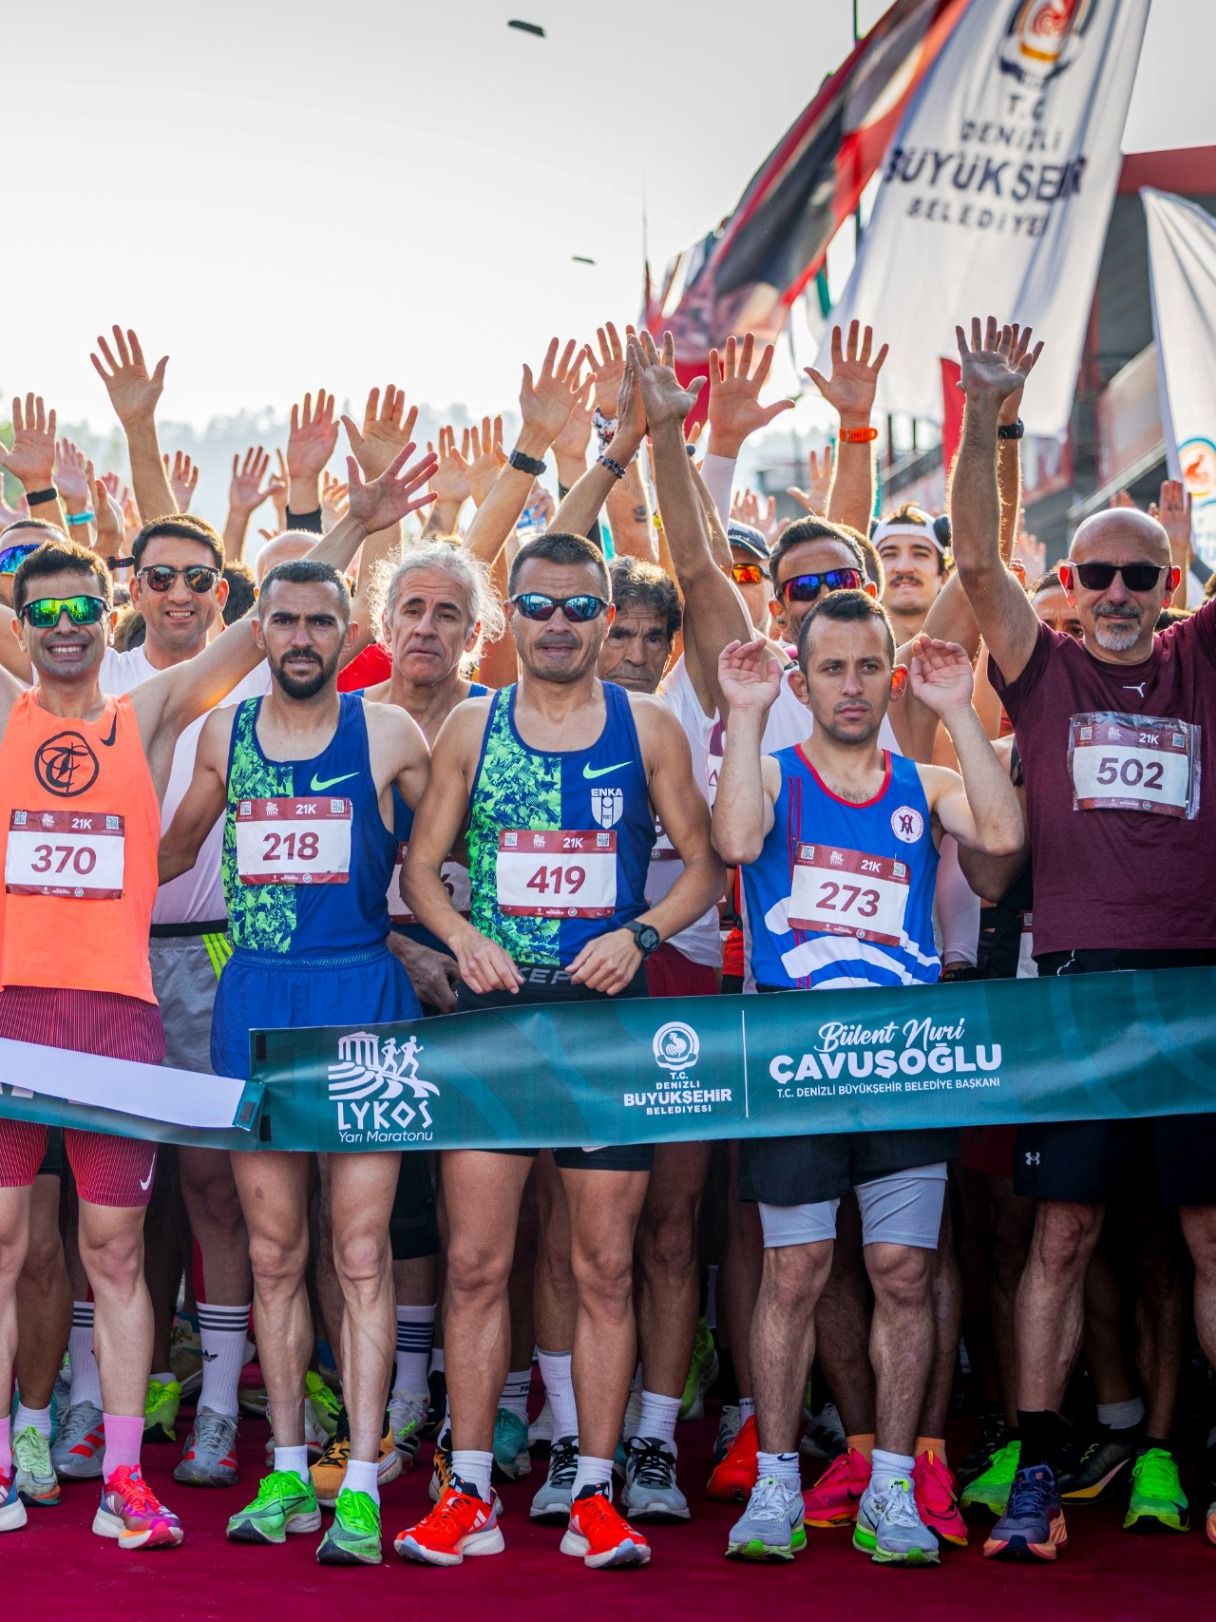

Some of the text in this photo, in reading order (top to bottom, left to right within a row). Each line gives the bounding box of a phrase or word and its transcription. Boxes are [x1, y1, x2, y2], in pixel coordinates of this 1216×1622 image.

[1138, 732, 1160, 745] 21K
[1096, 757, 1164, 790] 502
[591, 788, 623, 797] ENKA
[295, 803, 318, 815] 21K
[71, 818, 93, 829] 21K
[262, 832, 319, 861] 218
[562, 837, 584, 848] 21K
[31, 844, 97, 875] 370
[860, 859, 882, 873] 21K
[526, 866, 586, 894] 419
[816, 881, 880, 917] 273
[814, 1016, 965, 1053] Bülent Nuri
[769, 1042, 1002, 1084] ÇAVUŞOĞLU
[777, 1077, 1001, 1098] T.C. DENİZLİ BÜYÜKŞEHİR BELEDİYE BAŞKANI
[337, 1100, 433, 1130] LYKOS
[366, 1130, 433, 1143] Maratonu
